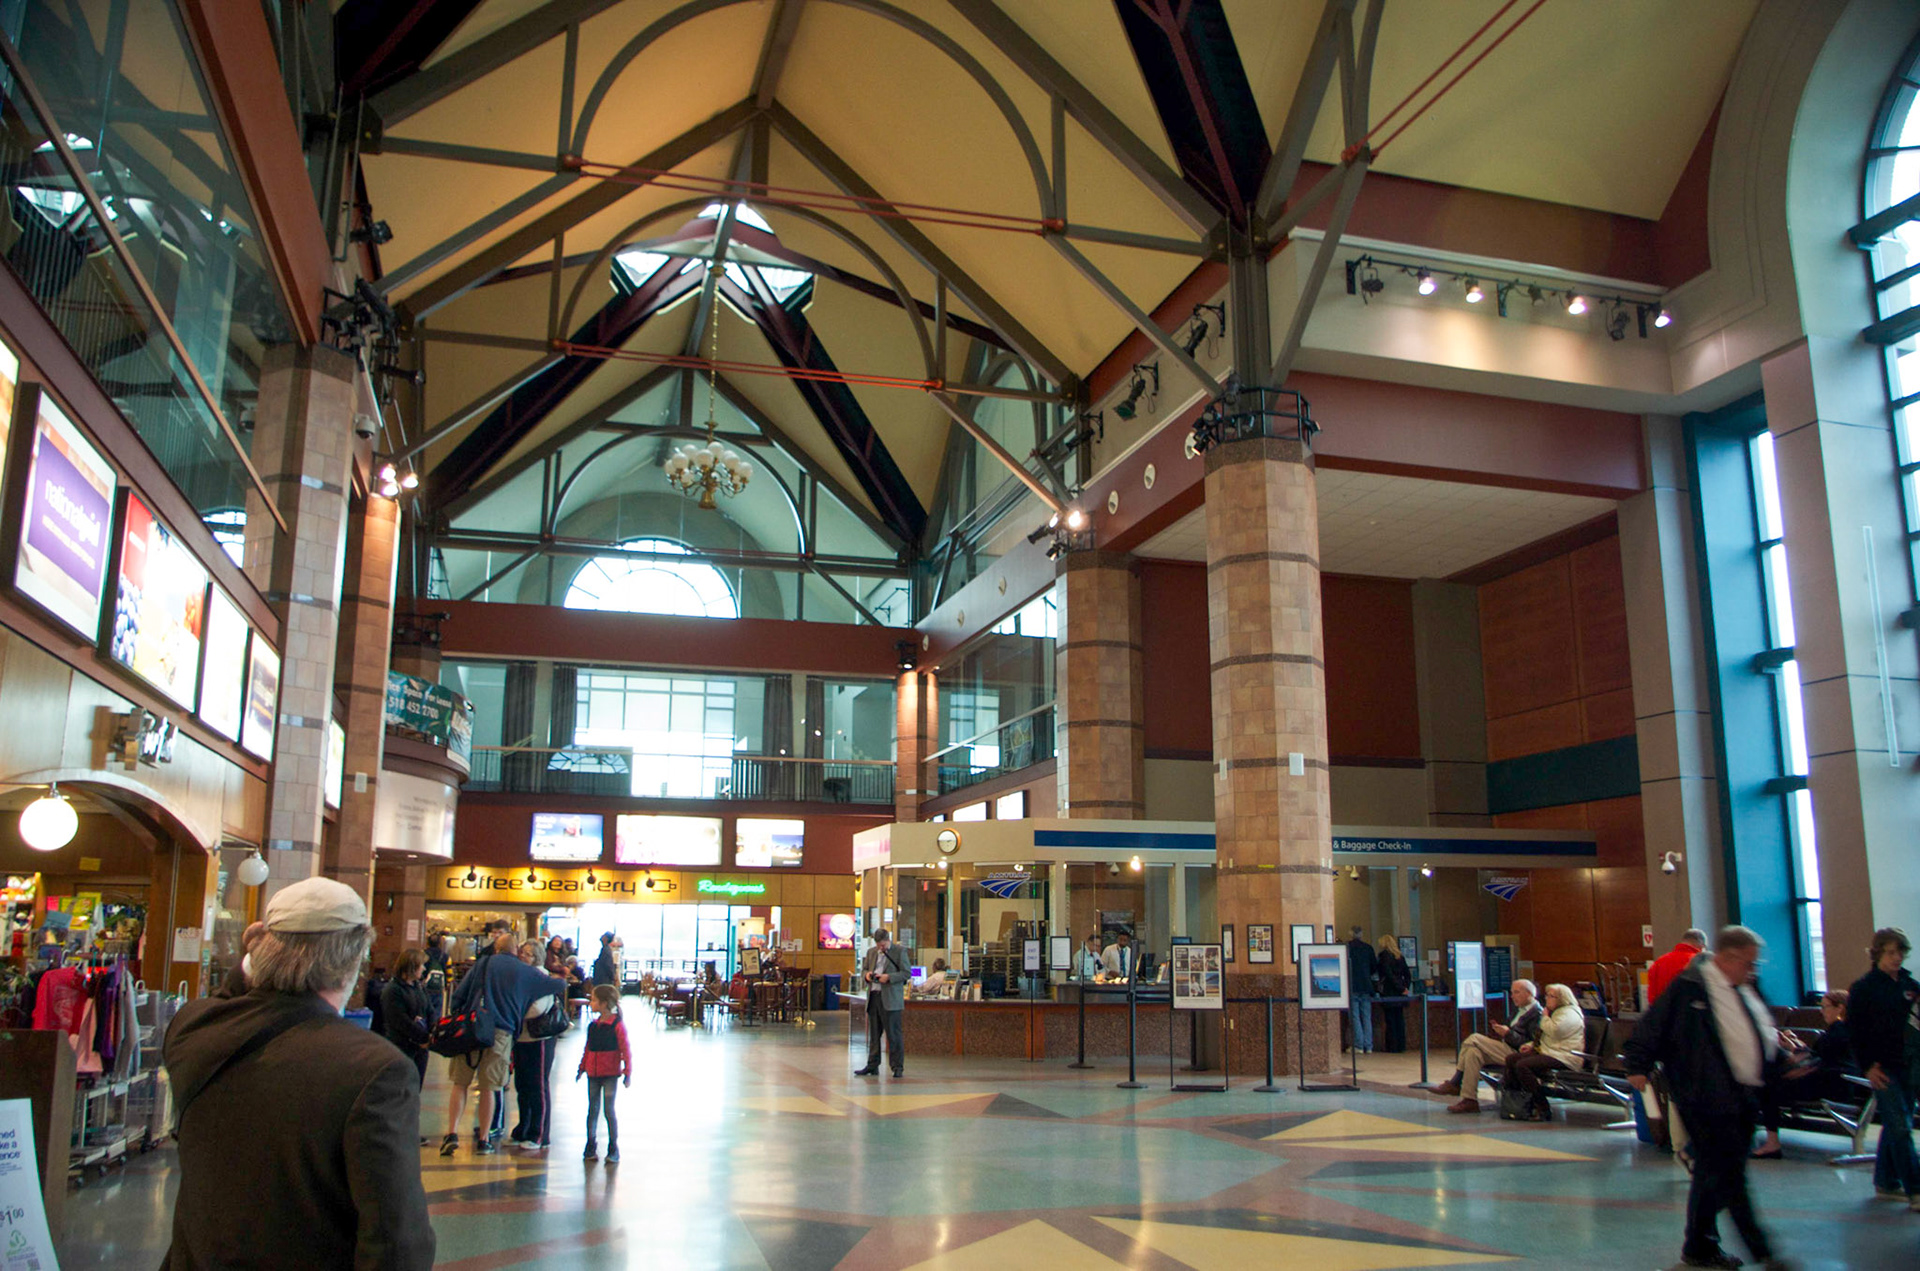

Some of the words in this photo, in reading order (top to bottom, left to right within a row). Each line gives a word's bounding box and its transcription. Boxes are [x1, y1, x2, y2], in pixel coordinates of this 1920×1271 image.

[403, 684, 423, 699] Space
[424, 691, 436, 702] For
[388, 696, 405, 710] 518
[406, 701, 421, 715] 452
[422, 705, 439, 720] 2700
[1332, 840, 1340, 849] &
[1341, 840, 1377, 851] Baggage
[1378, 841, 1412, 850] Check-In
[446, 875, 523, 891] coffee
